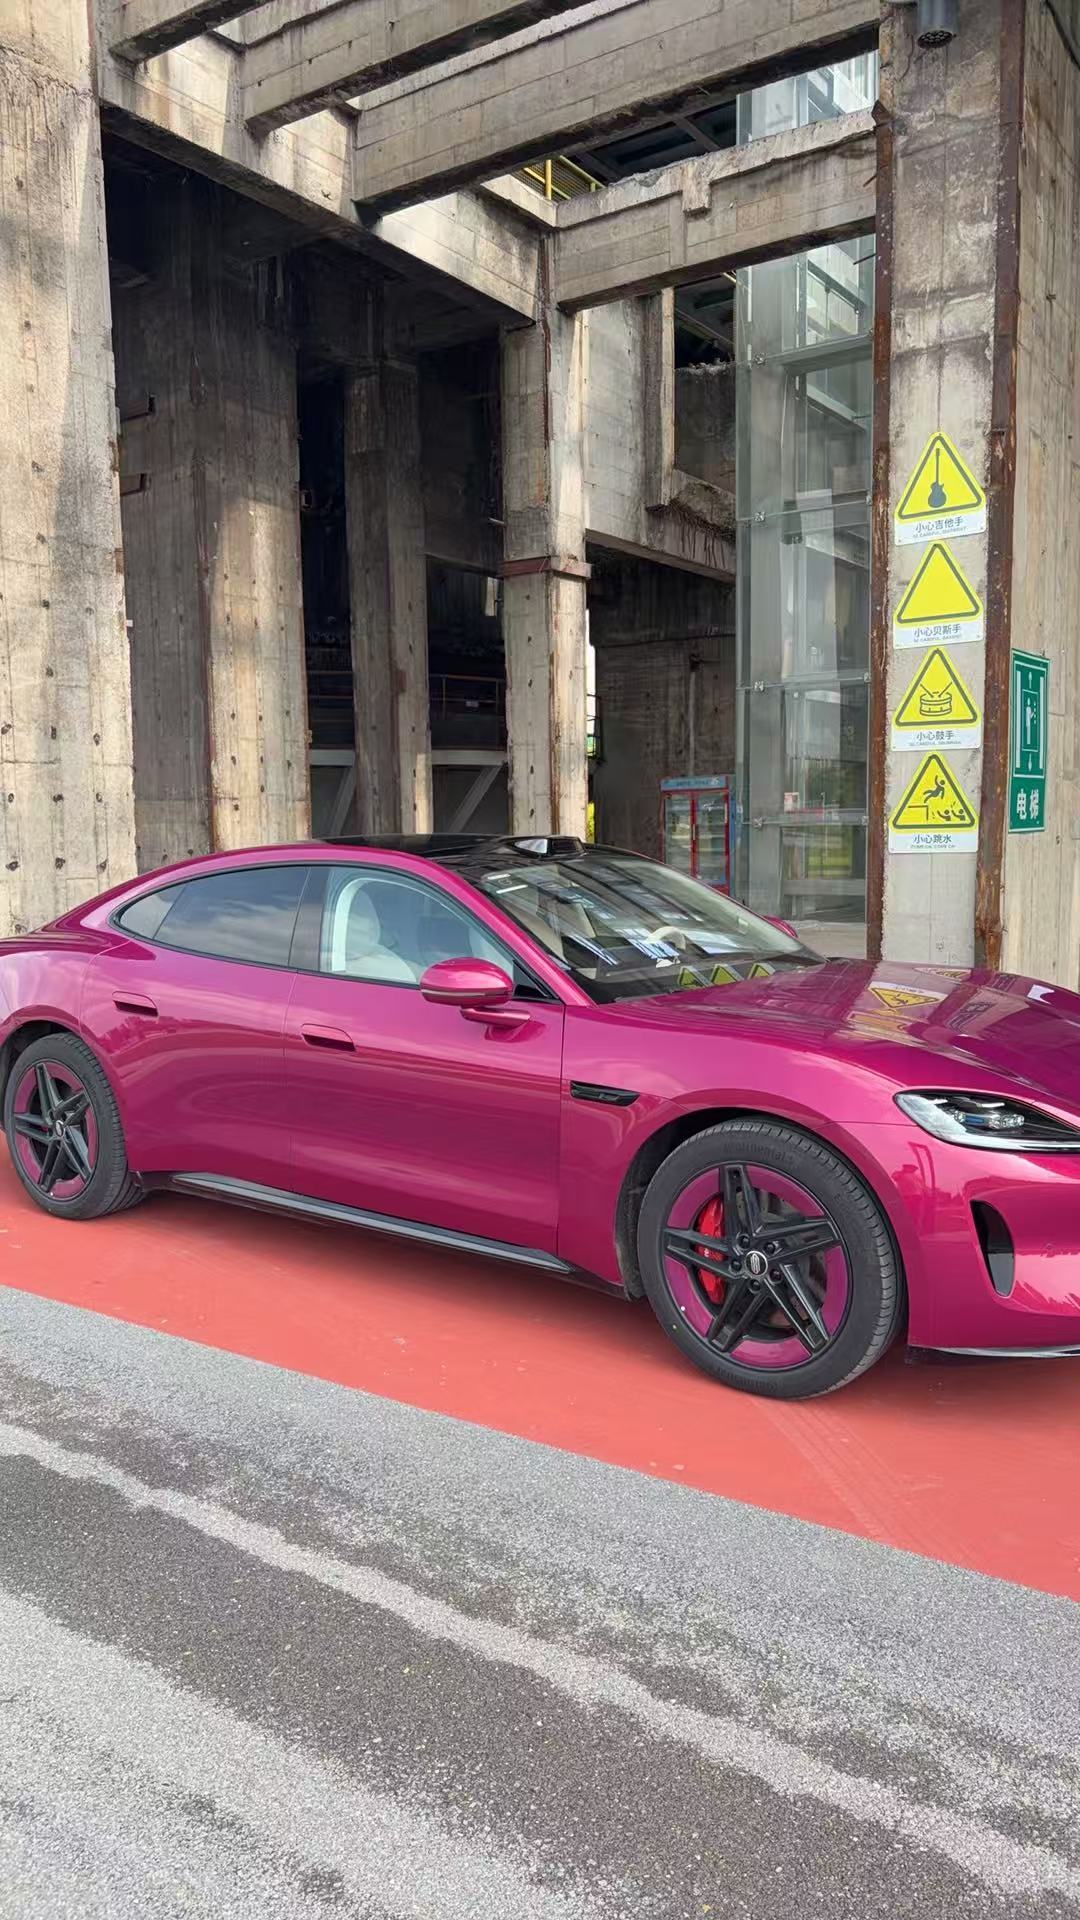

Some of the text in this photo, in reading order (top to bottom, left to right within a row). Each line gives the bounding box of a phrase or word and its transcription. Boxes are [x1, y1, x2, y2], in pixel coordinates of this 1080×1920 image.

[915, 516, 963, 533] 小心吉他手
[914, 624, 961, 637] 小心贝斯手
[916, 730, 955, 741] 小心鼓手
[1016, 788, 1039, 820] 电梯
[913, 834, 952, 844] 小心跳水
